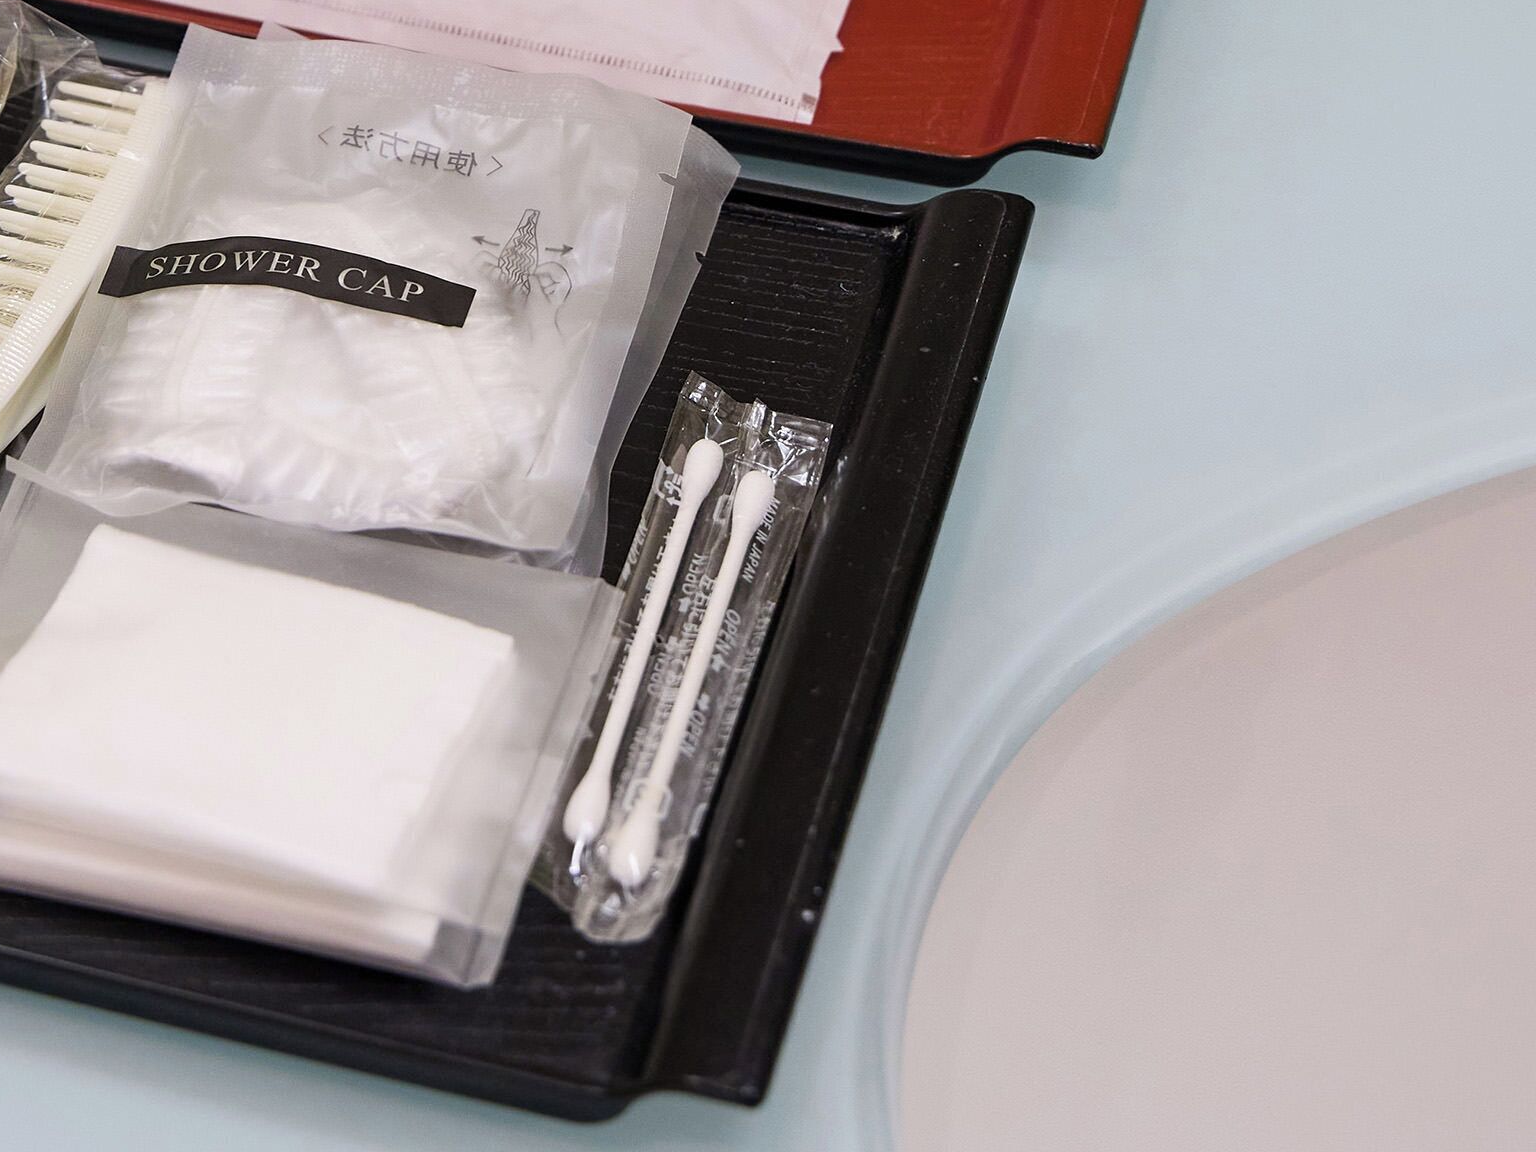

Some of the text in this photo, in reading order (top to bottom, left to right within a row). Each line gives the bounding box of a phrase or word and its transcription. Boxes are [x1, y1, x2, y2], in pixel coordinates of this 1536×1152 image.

[145, 250, 426, 304] SHOWER CAP
[742, 495, 781, 583] MADE IN JAPAN
[682, 553, 708, 595] OPEN
[716, 608, 742, 655] OPEN
[680, 710, 706, 757] OPEN
